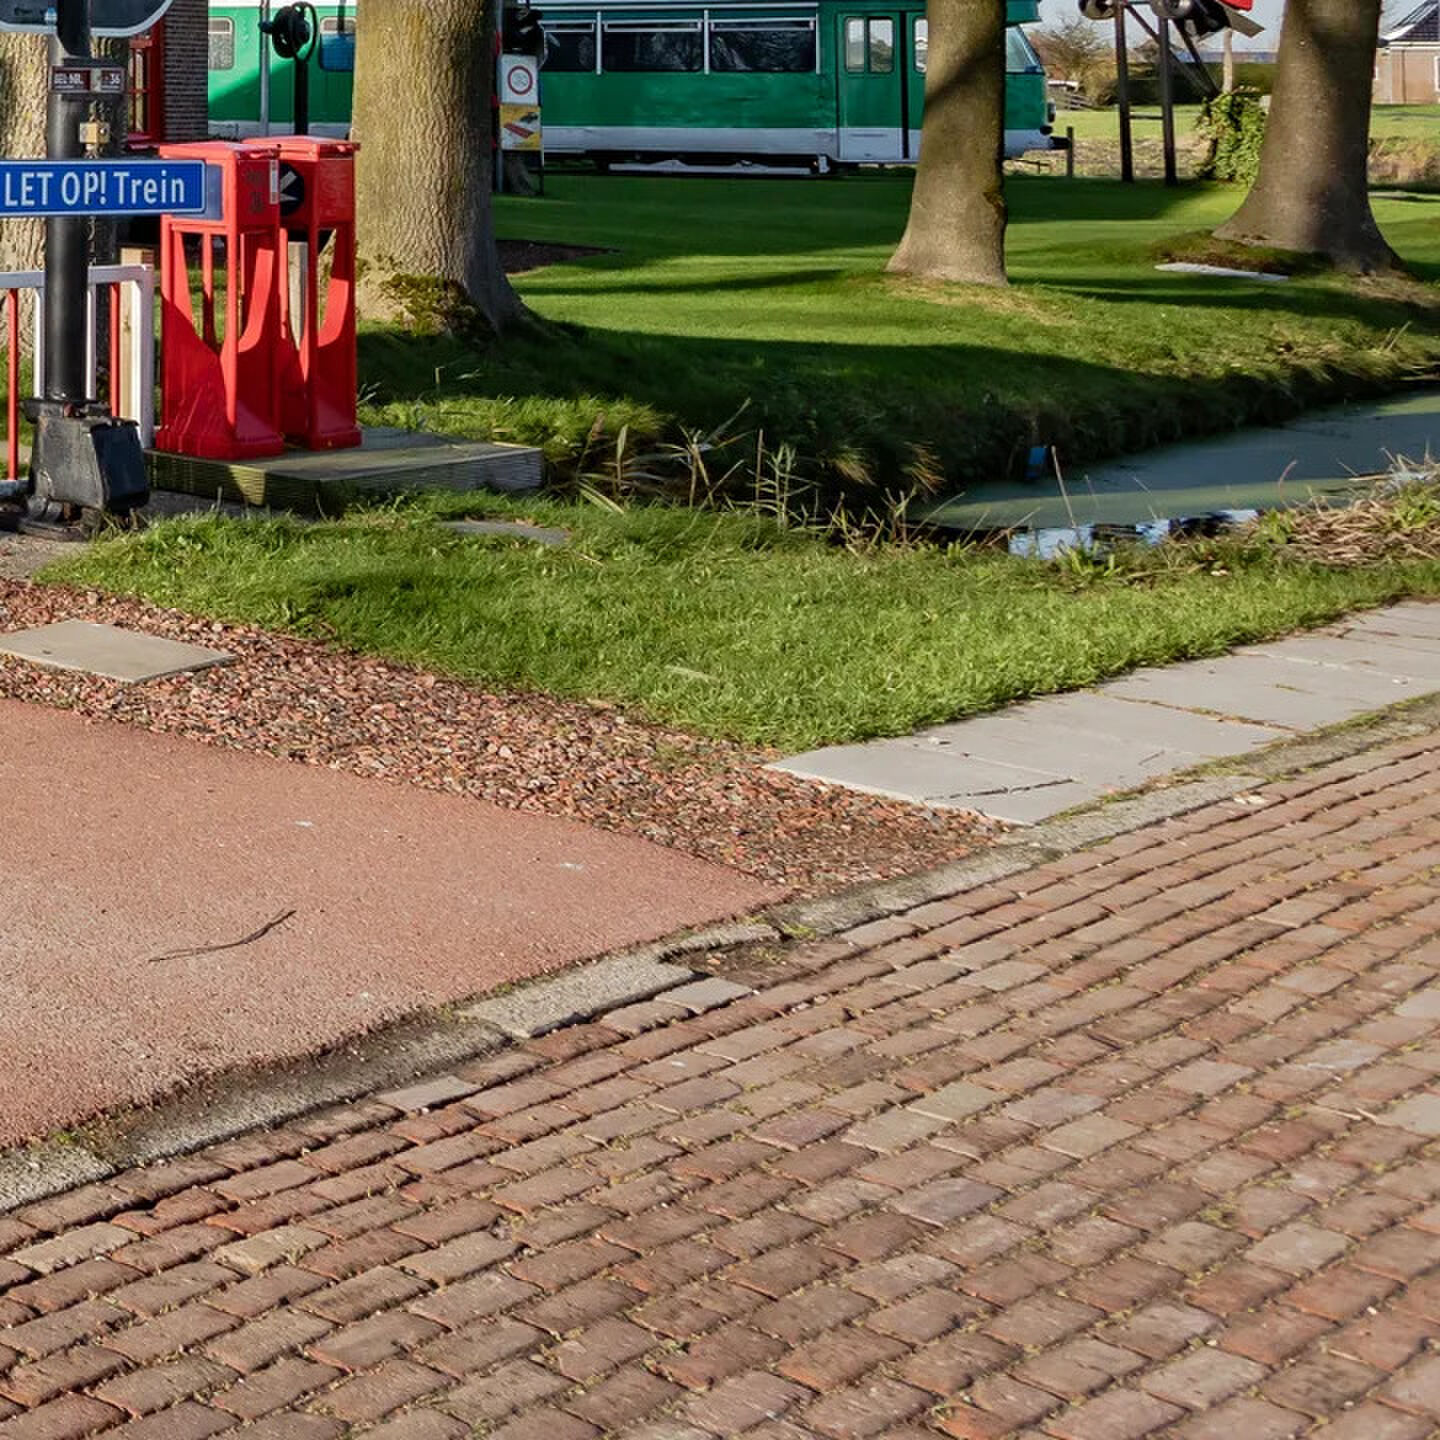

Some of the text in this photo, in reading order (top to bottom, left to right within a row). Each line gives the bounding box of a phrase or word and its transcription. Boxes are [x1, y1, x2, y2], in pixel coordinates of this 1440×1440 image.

[4, 169, 185, 207] LET OP! Trein
